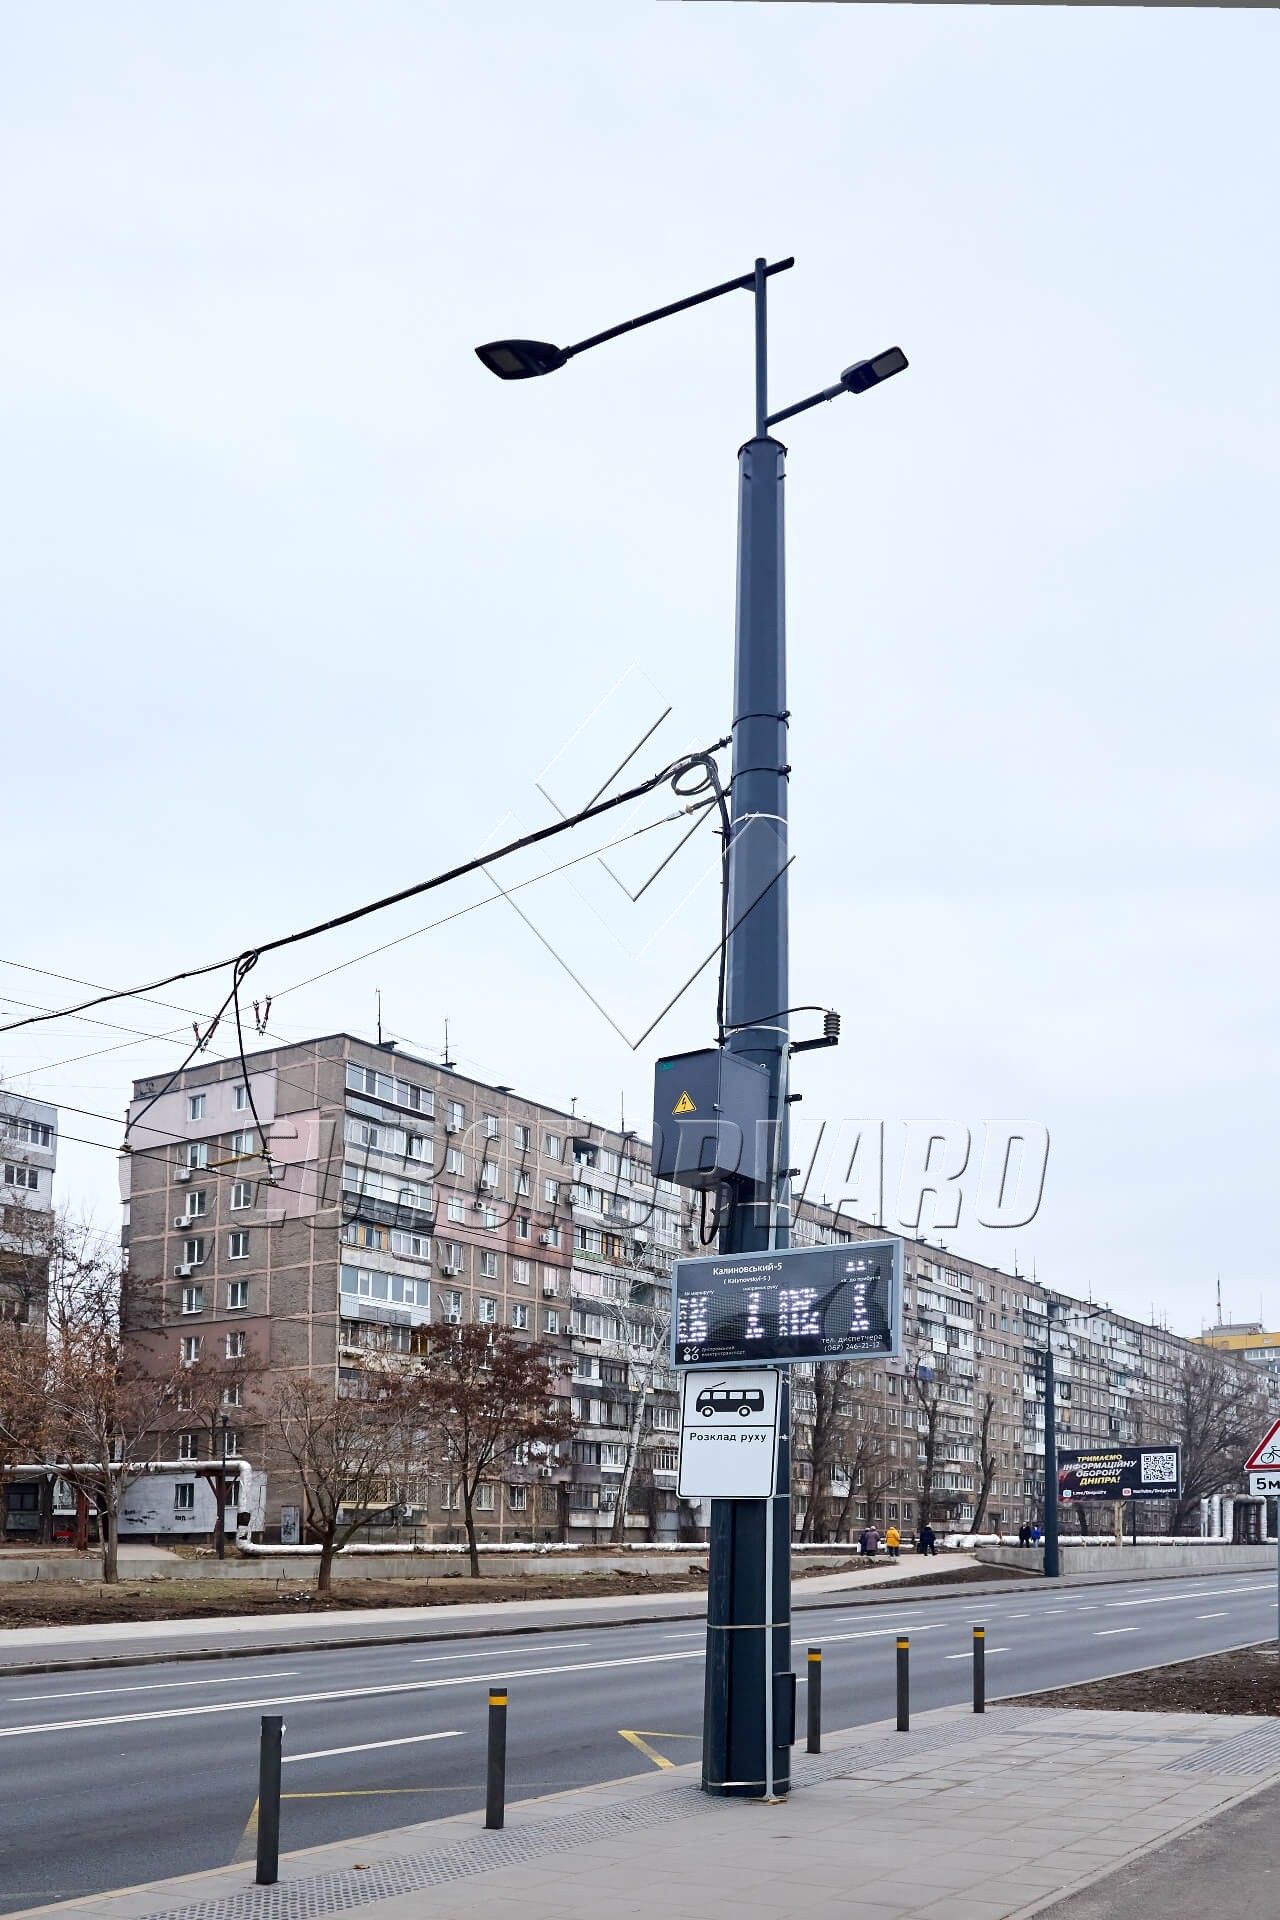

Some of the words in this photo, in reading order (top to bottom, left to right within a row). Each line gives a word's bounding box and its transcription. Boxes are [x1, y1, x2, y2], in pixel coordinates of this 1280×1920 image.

[712, 1262, 783, 1276] Калиновський-5
[689, 1432, 737, 1442] Розклад
[740, 1433, 767, 1443] руху
[1076, 1454, 1123, 1463] ТРИМАЄМО
[1063, 1459, 1137, 1471] ІНФОРМАЦІЙНУ
[1075, 1468, 1122, 1478] ОБОРОНУ
[1079, 1476, 1121, 1486] ДНІПРА!
